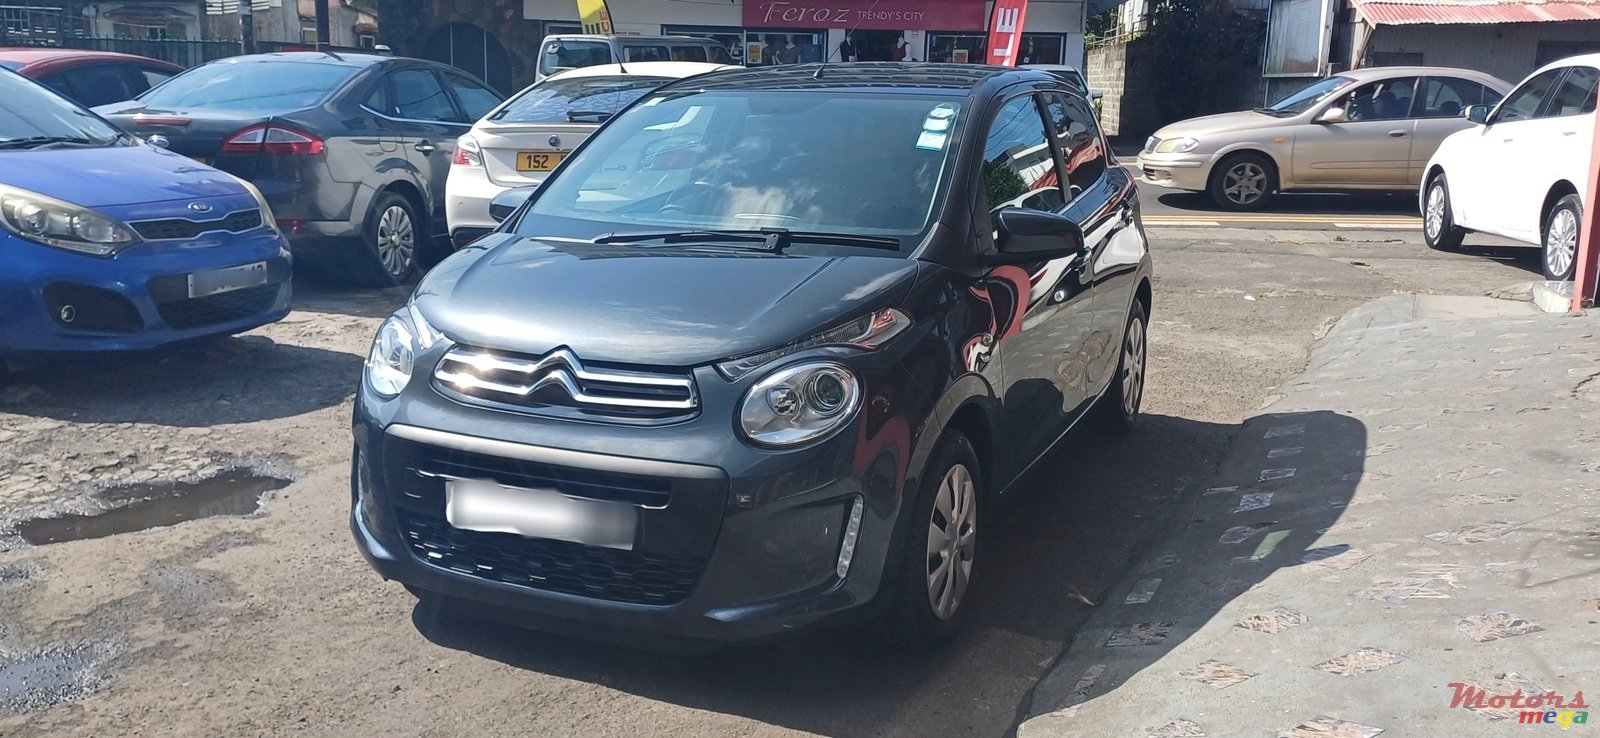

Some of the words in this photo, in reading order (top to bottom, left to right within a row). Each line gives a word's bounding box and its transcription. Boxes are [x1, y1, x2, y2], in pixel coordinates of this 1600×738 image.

[759, 1, 850, 23] Feroz
[857, 10, 901, 20] TRENDY'S
[904, 11, 925, 21] CITY
[993, 8, 1018, 66] LE
[526, 154, 549, 169] 152
